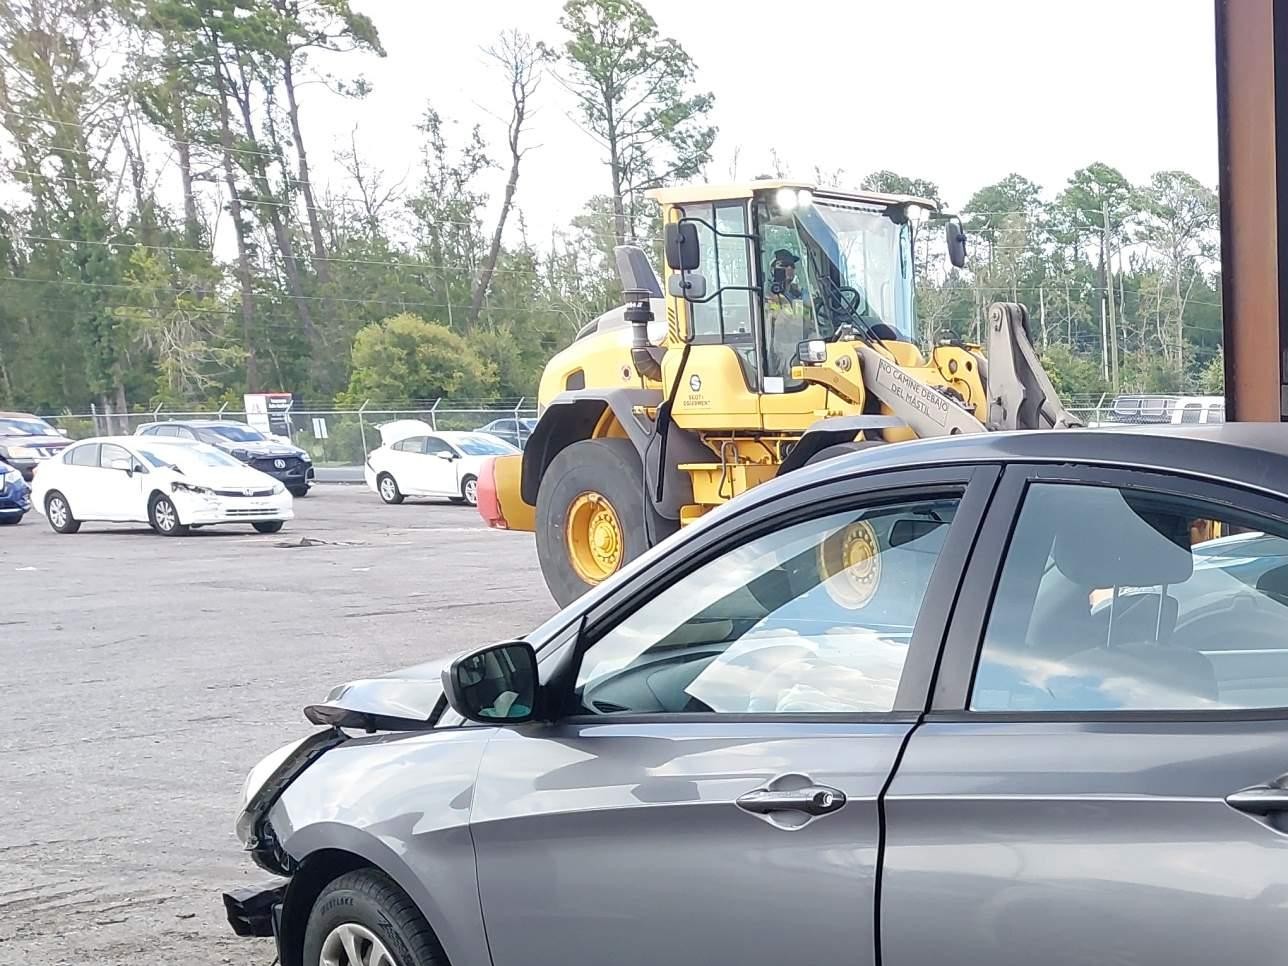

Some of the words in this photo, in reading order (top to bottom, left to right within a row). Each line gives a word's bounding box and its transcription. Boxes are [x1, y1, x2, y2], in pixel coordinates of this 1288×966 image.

[880, 361, 892, 374] NO
[893, 369, 920, 393] CAMINE
[921, 388, 948, 411] DEBAJO
[891, 383, 904, 398] DEL
